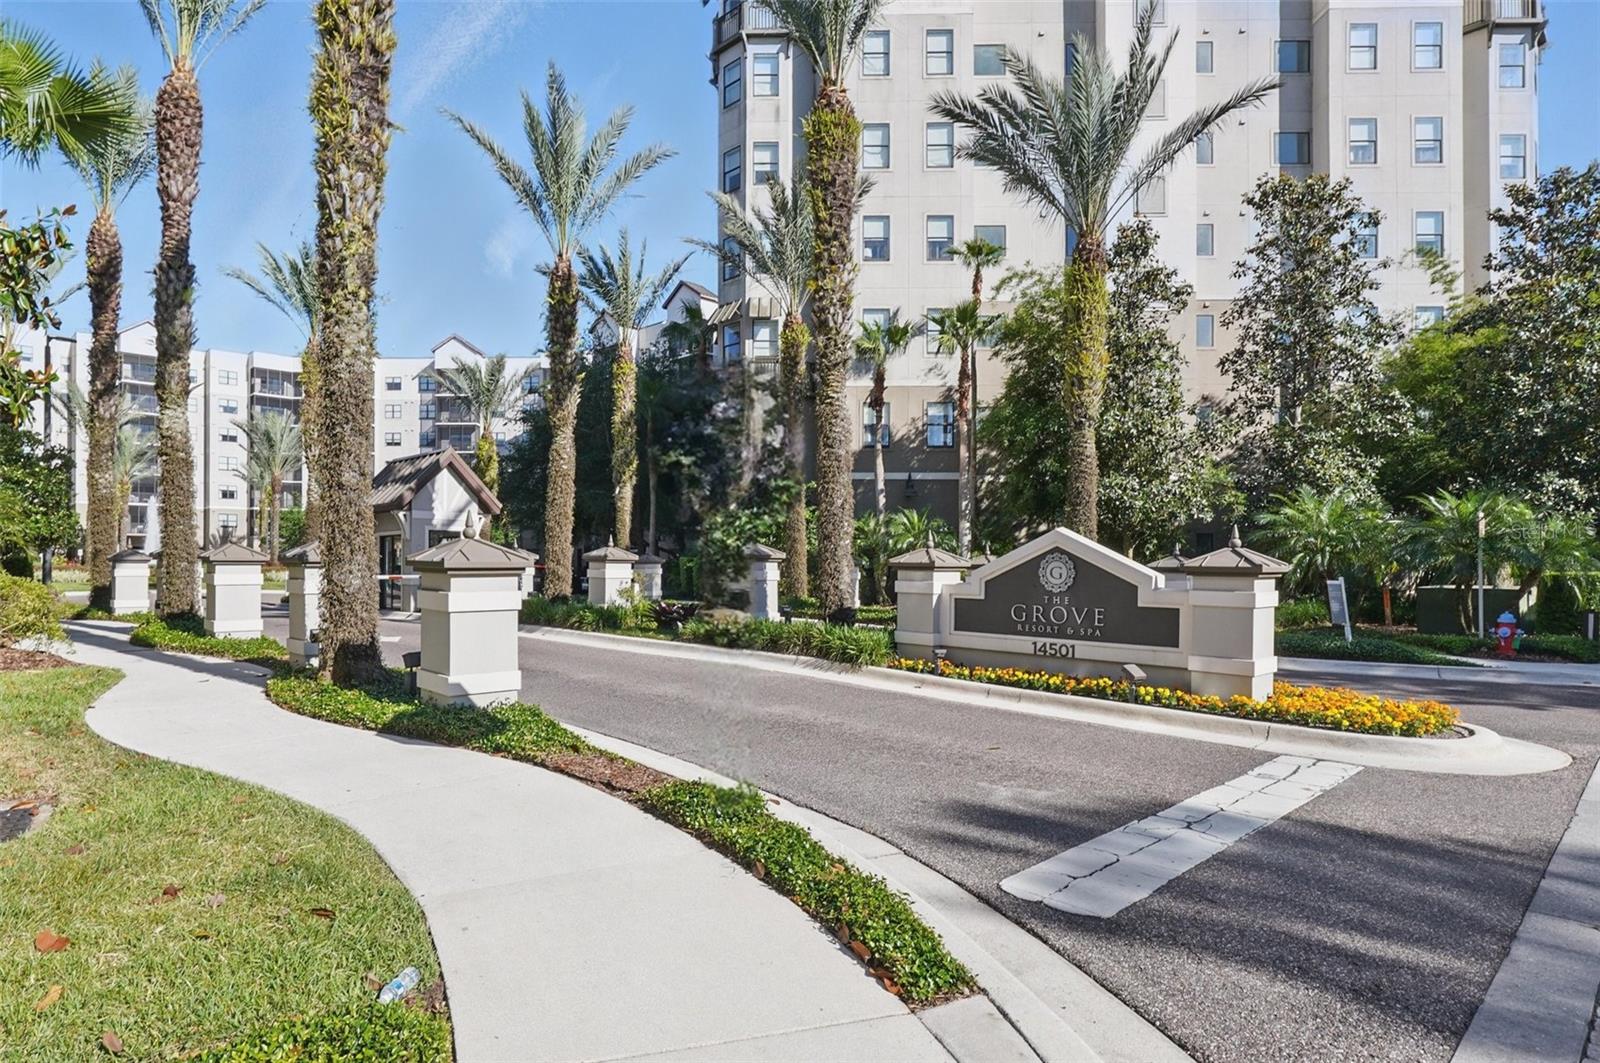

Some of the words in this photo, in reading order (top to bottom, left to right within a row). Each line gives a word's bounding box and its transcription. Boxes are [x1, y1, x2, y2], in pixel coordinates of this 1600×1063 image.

[1049, 566, 1063, 580] G
[1043, 595, 1070, 605] THE
[1010, 603, 1105, 626] GROVE
[1017, 623, 1059, 634] RESORT
[1066, 627, 1074, 635] &
[1080, 627, 1101, 637] SPA
[1032, 641, 1075, 658] 14501
